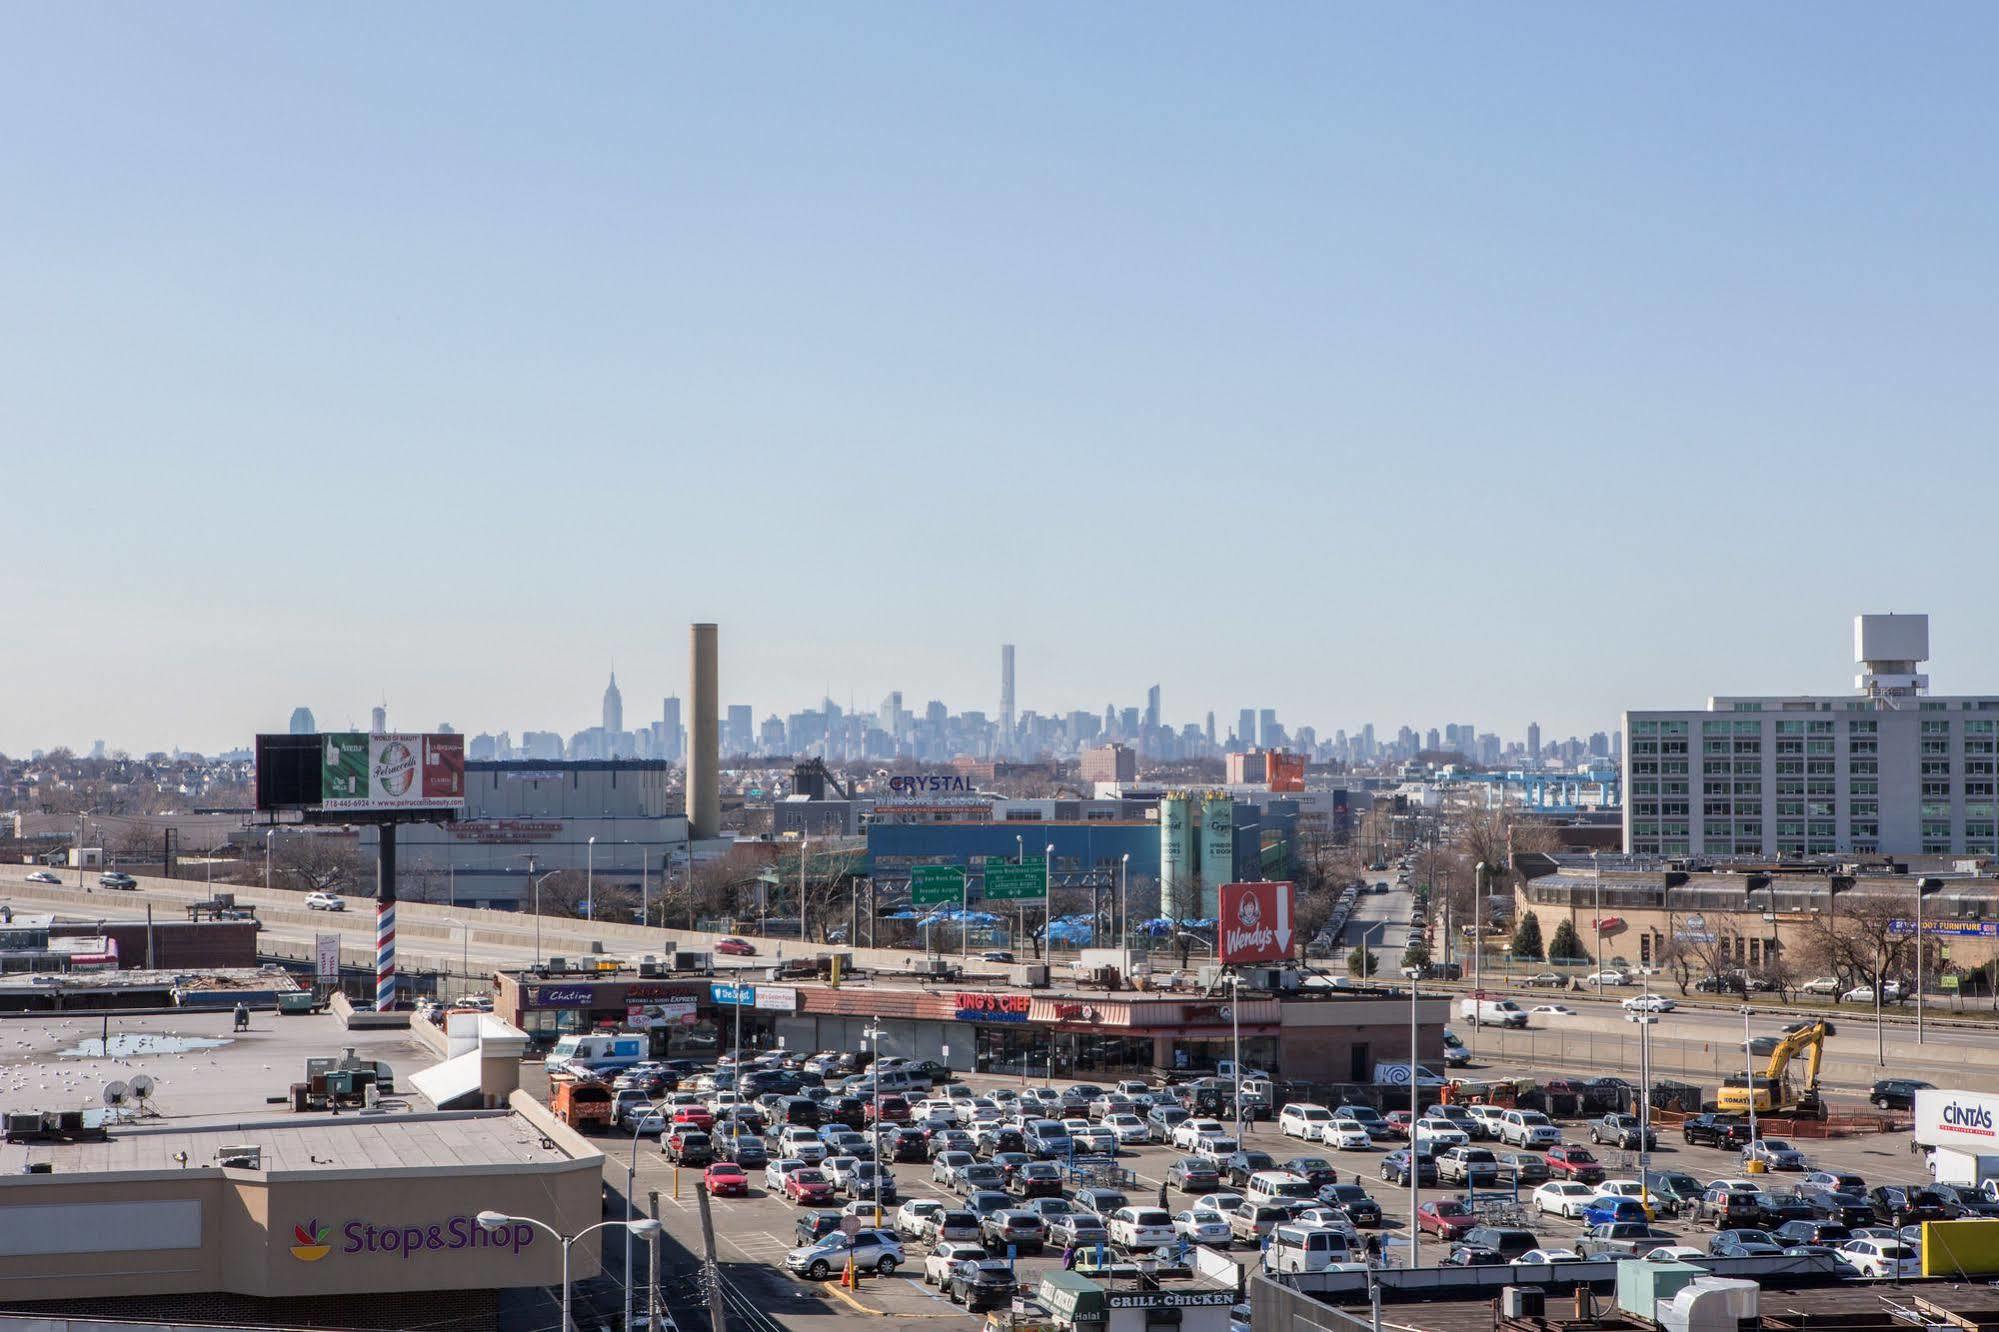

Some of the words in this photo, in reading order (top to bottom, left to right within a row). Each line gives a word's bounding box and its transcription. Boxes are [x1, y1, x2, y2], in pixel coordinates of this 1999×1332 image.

[889, 776, 977, 791] CRYSTAL
[1939, 922, 1981, 931] FURNITURE
[1227, 922, 1273, 955] Wendy's
[550, 991, 592, 1000] Chatime
[956, 994, 995, 1009] KING'S
[1001, 995, 1029, 1011] CHEF
[344, 1216, 535, 1259] Stop&Shop
[1075, 1312, 1100, 1320] Halal
